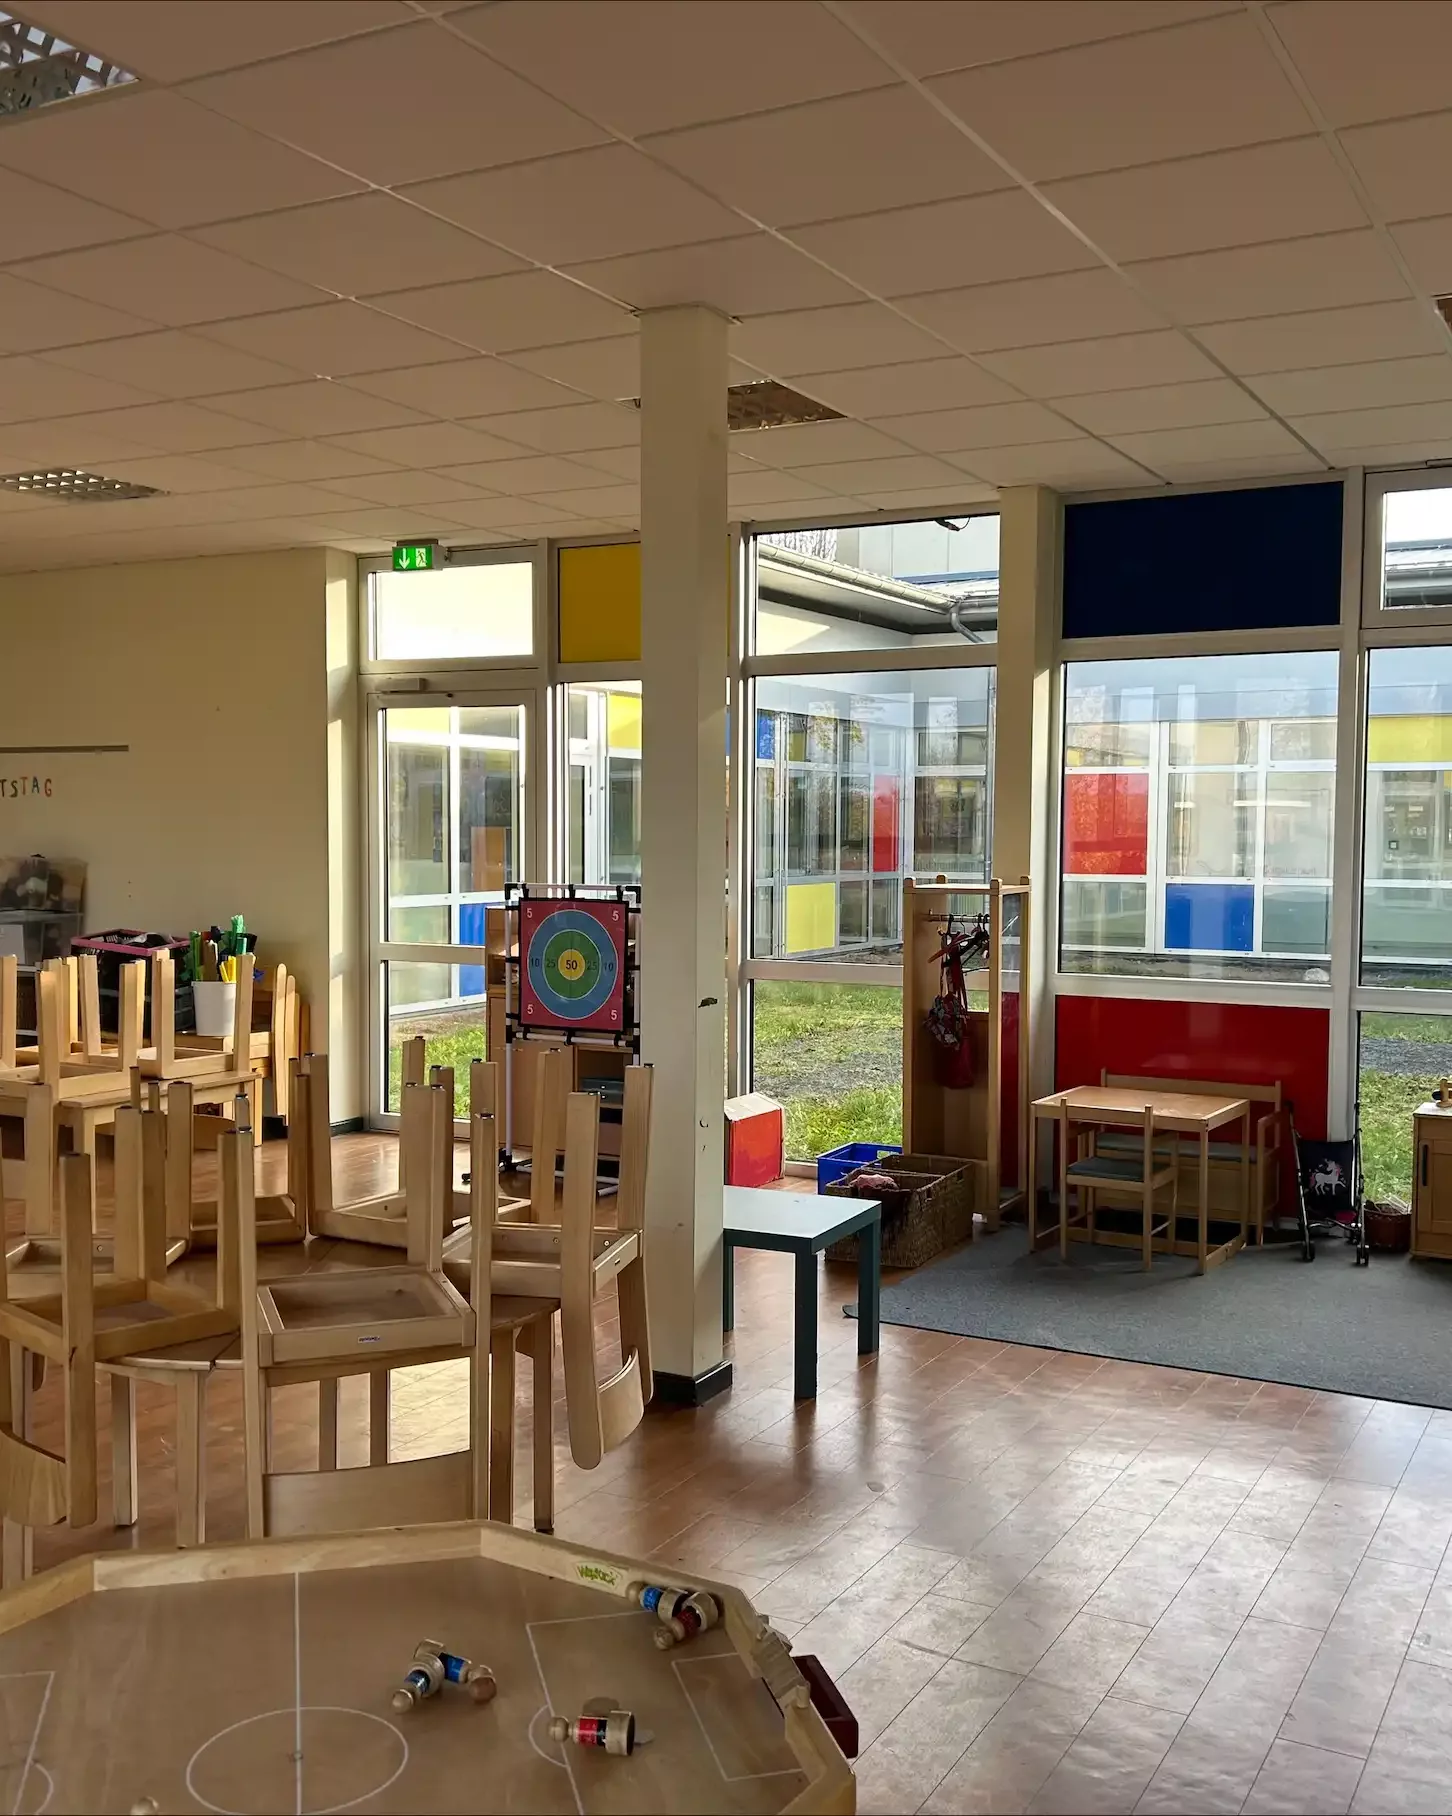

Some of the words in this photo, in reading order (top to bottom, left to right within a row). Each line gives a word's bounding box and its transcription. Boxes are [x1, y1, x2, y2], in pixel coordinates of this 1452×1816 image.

[526, 908, 533, 918] 5
[611, 911, 619, 921] 5
[530, 958, 540, 967] 10
[546, 959, 556, 968] 25
[565, 960, 578, 970] 50
[586, 961, 598, 970] 25
[527, 1004, 534, 1015] 5
[611, 1010, 618, 1020] 5
